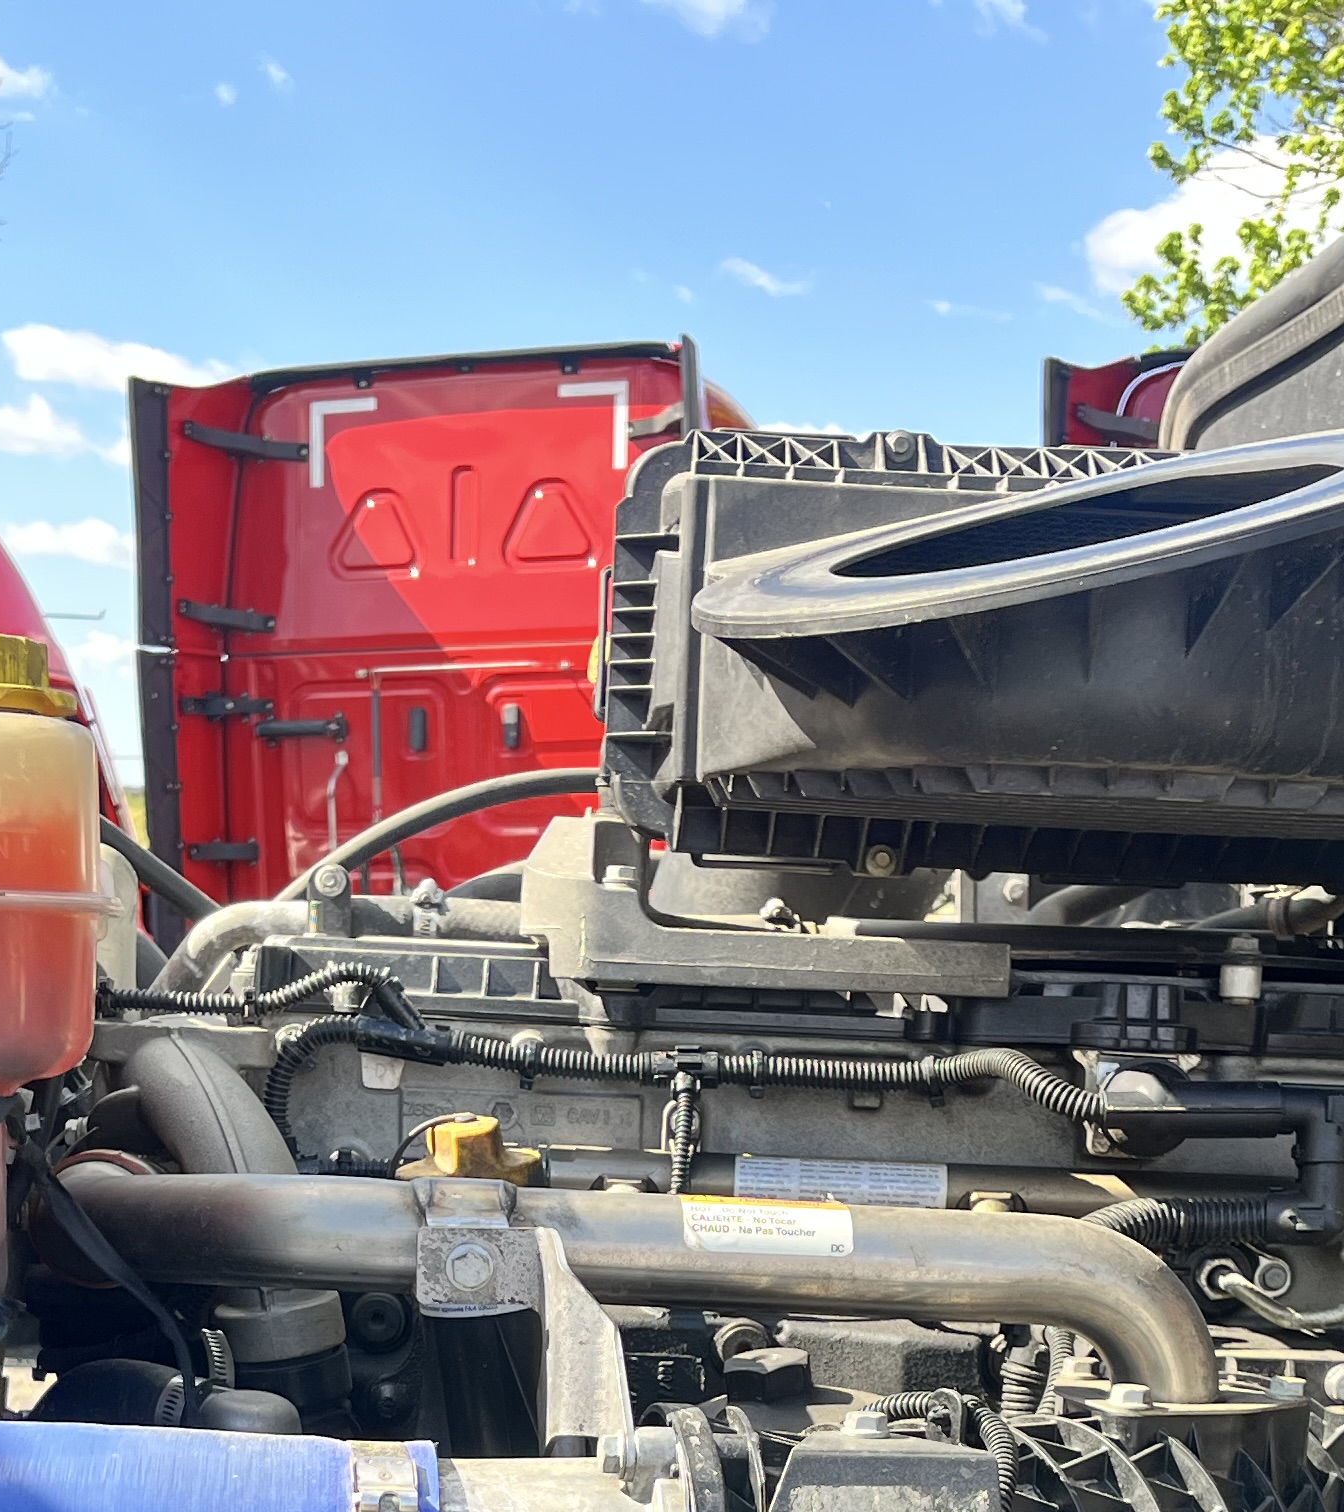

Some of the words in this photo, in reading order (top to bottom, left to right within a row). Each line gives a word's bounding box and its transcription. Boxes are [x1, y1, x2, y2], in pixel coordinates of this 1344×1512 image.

[691, 1213, 743, 1223] CALIENTE
[753, 1216, 767, 1225] No
[769, 1217, 797, 1227] Tocar
[692, 1223, 730, 1233] CHAUD
[756, 1227, 774, 1236] Pas
[776, 1227, 817, 1238] Toucher
[830, 1244, 845, 1254] DC
